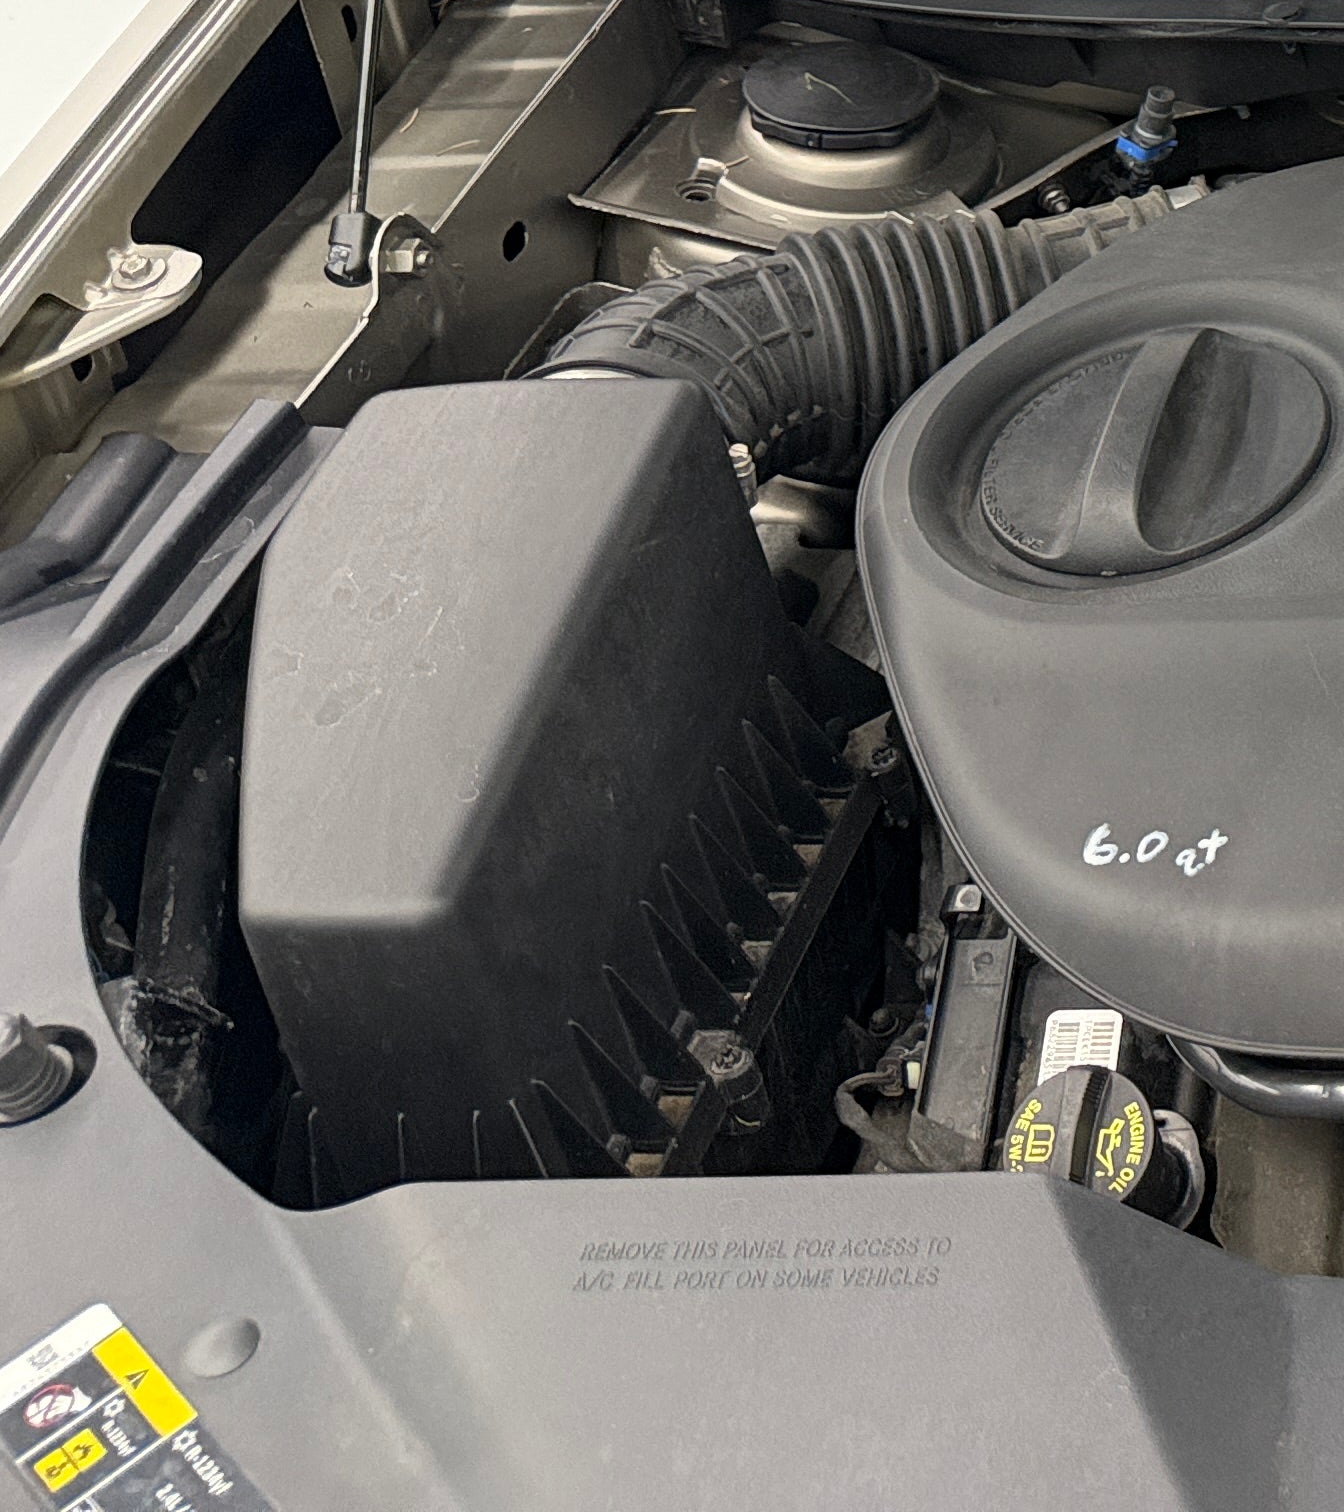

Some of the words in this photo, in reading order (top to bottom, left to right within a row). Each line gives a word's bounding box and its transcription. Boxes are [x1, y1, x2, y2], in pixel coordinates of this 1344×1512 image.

[1082, 822, 1170, 866] 6.0
[1014, 1098, 1042, 1133] SAE
[1123, 1101, 1145, 1166] ENGINE
[1108, 1168, 1135, 1194] OIL
[579, 1240, 668, 1263] REMOVE
[670, 1239, 717, 1262] THIS
[721, 1239, 787, 1260] PANEL
[793, 1238, 836, 1259] FOR
[839, 1237, 919, 1258] ACCESS
[623, 1269, 666, 1290] FILL
[673, 1269, 727, 1289] PORT
[735, 1268, 767, 1288] ON
[772, 1267, 835, 1289] SOME
[842, 1265, 941, 1288] VEHICLES
